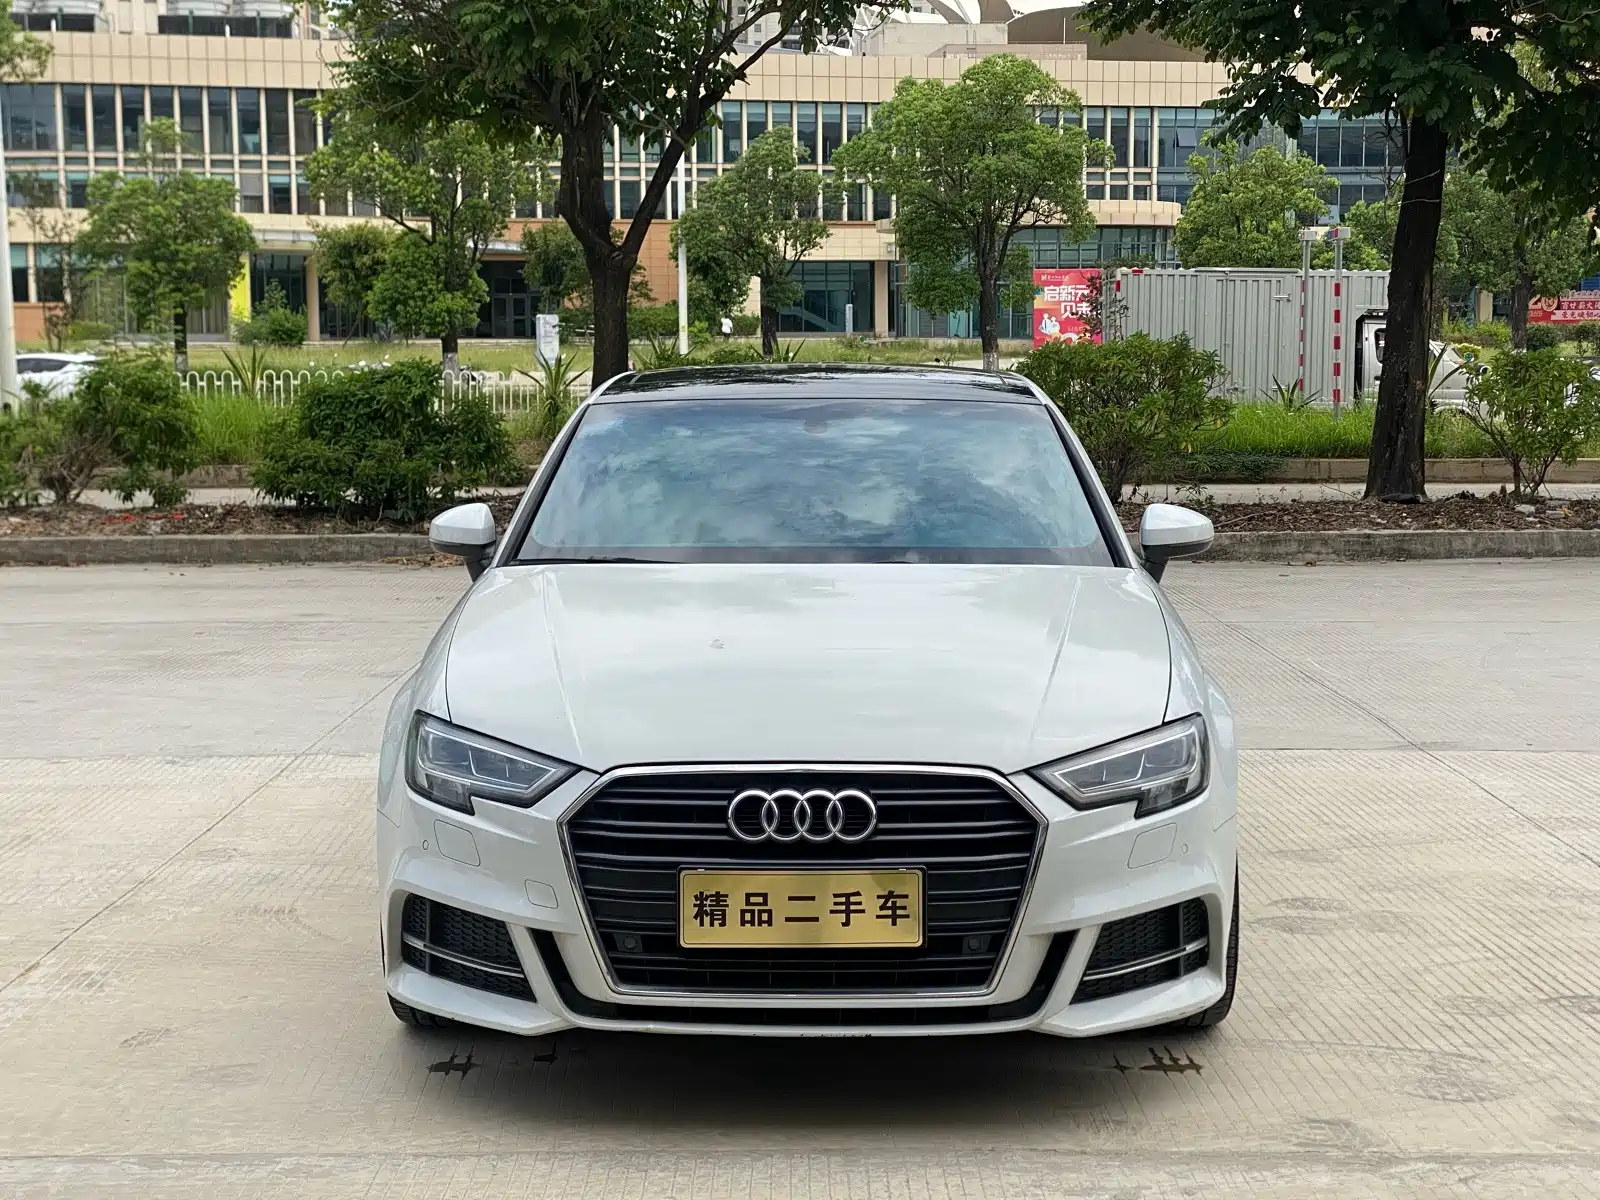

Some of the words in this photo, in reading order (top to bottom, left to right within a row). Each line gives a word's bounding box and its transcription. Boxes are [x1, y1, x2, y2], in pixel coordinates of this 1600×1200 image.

[693, 891, 910, 927] 精品二手车
